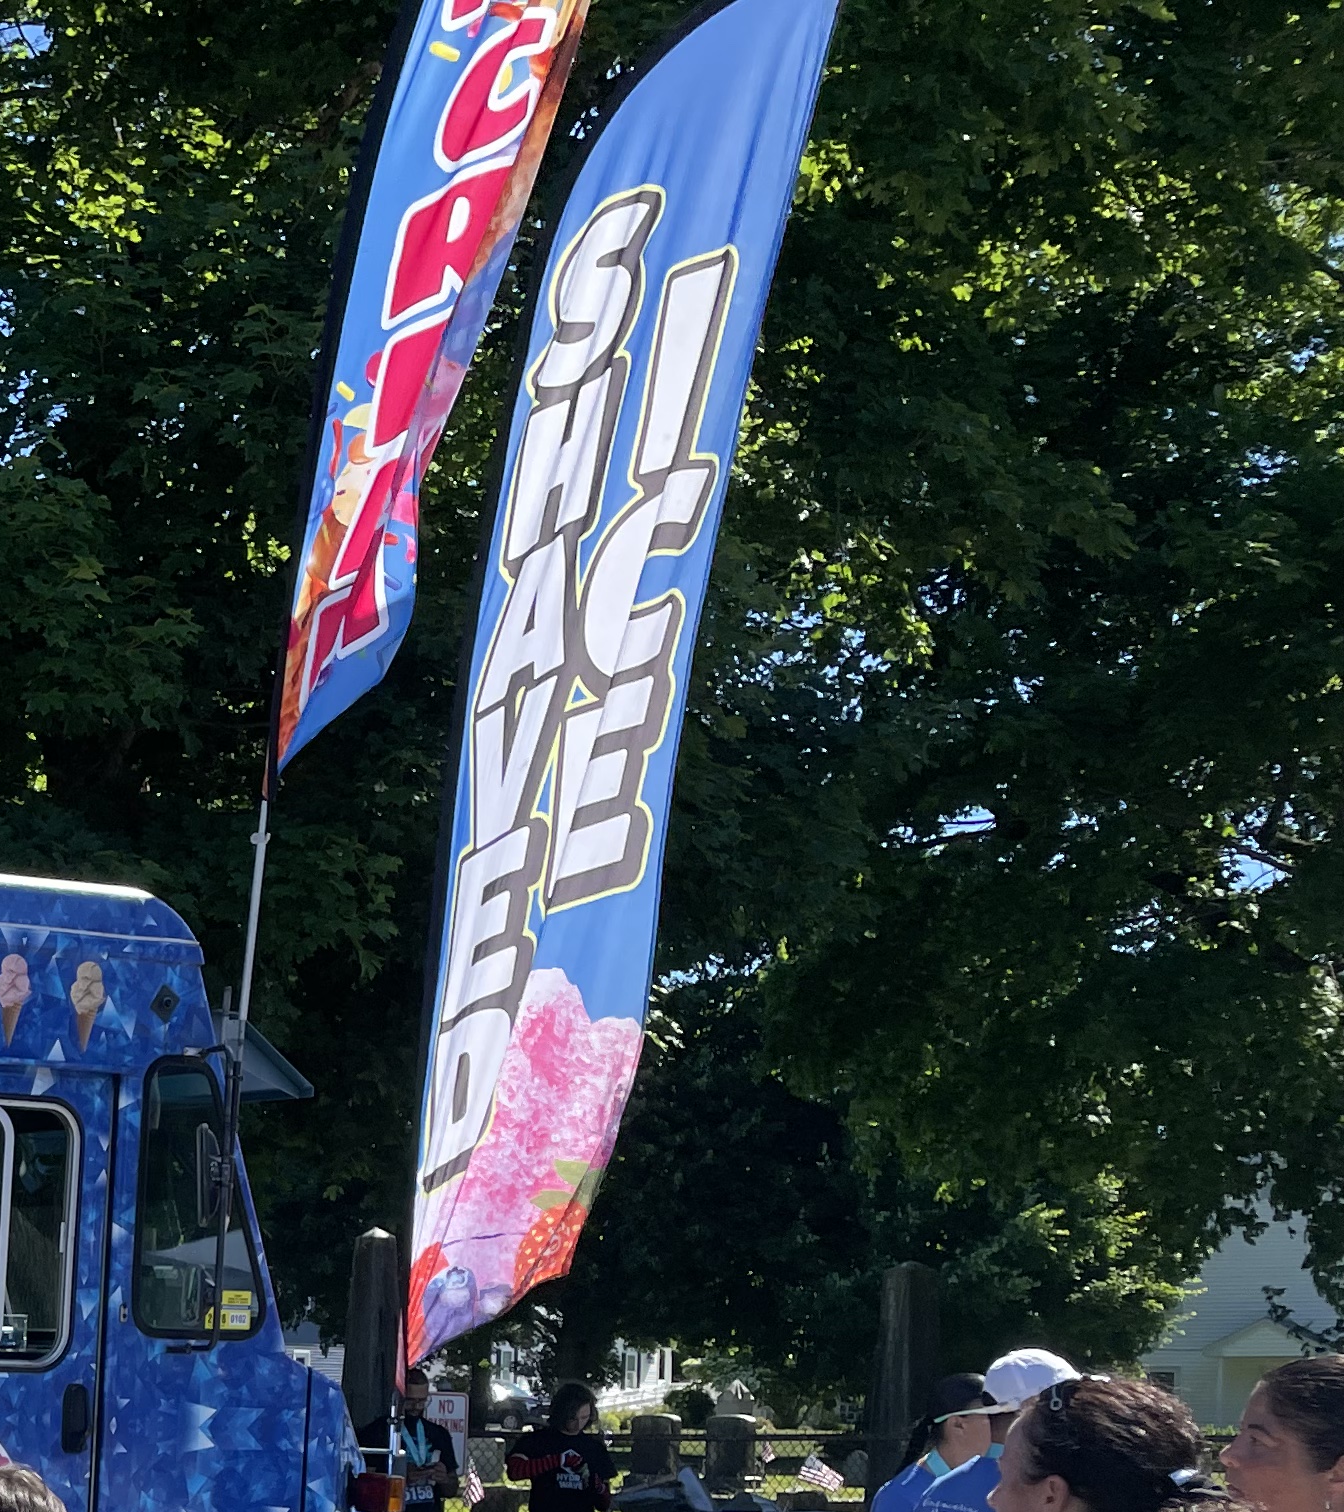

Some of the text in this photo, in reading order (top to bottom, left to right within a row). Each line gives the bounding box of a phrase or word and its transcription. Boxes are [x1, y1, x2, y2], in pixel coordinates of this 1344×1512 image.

[420, 186, 664, 1194] SHAVED
[543, 247, 736, 908] ICE
[438, 1399, 455, 1414] NO
